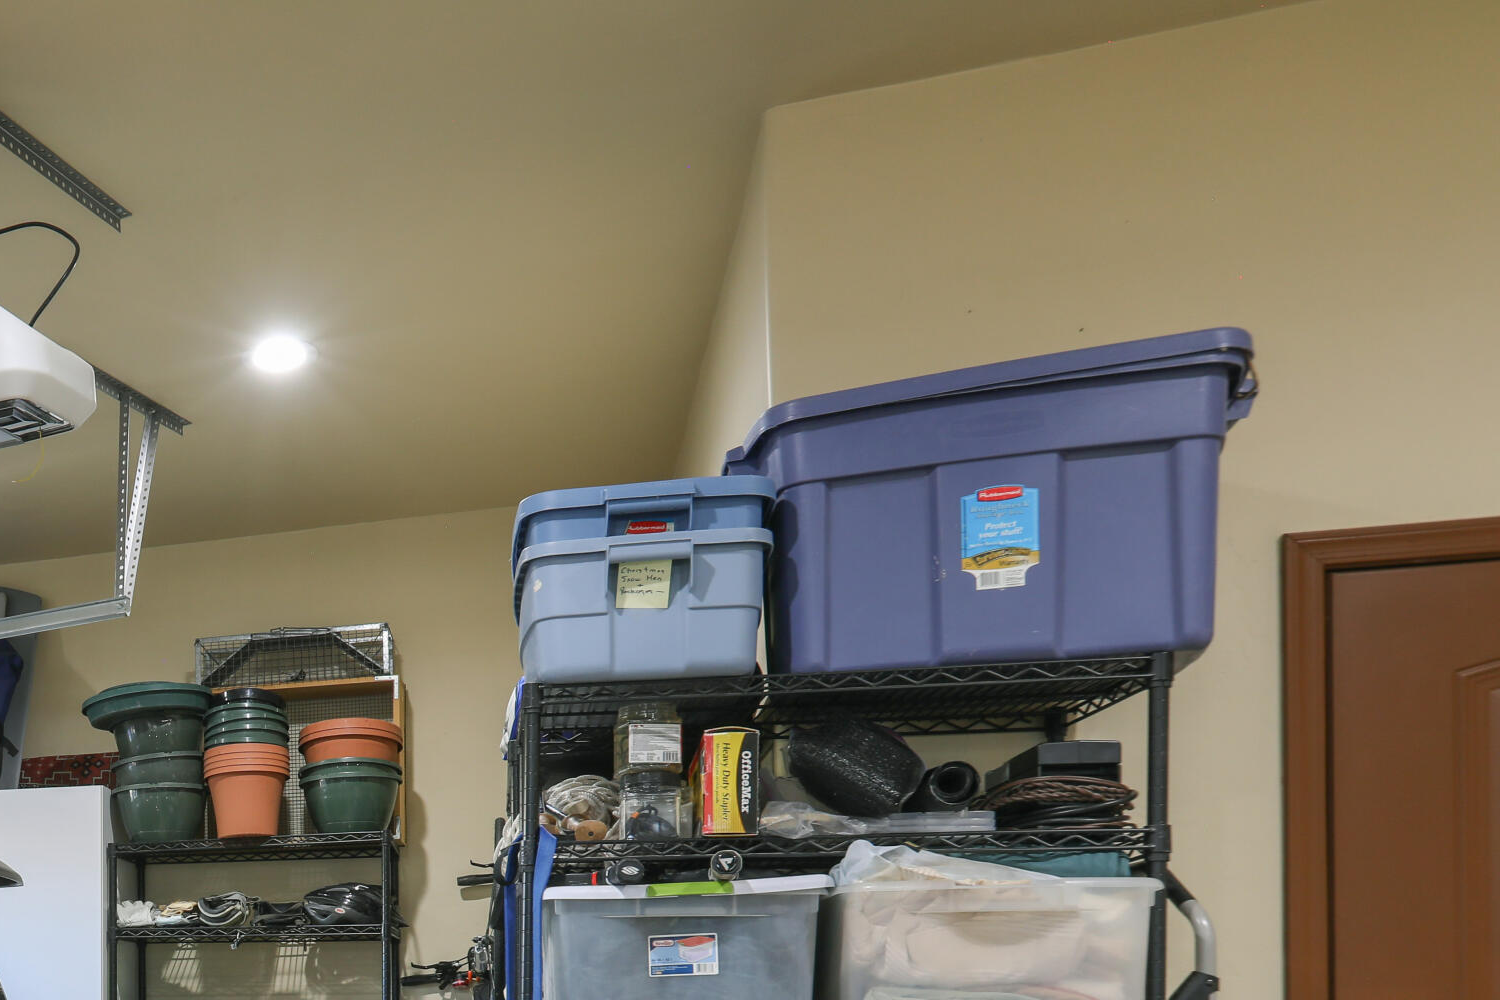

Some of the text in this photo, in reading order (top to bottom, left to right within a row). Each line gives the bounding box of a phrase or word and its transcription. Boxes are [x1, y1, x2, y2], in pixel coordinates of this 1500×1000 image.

[720, 742, 731, 821] Heavy Duty Stapler
[741, 750, 753, 814] OfficeMax
